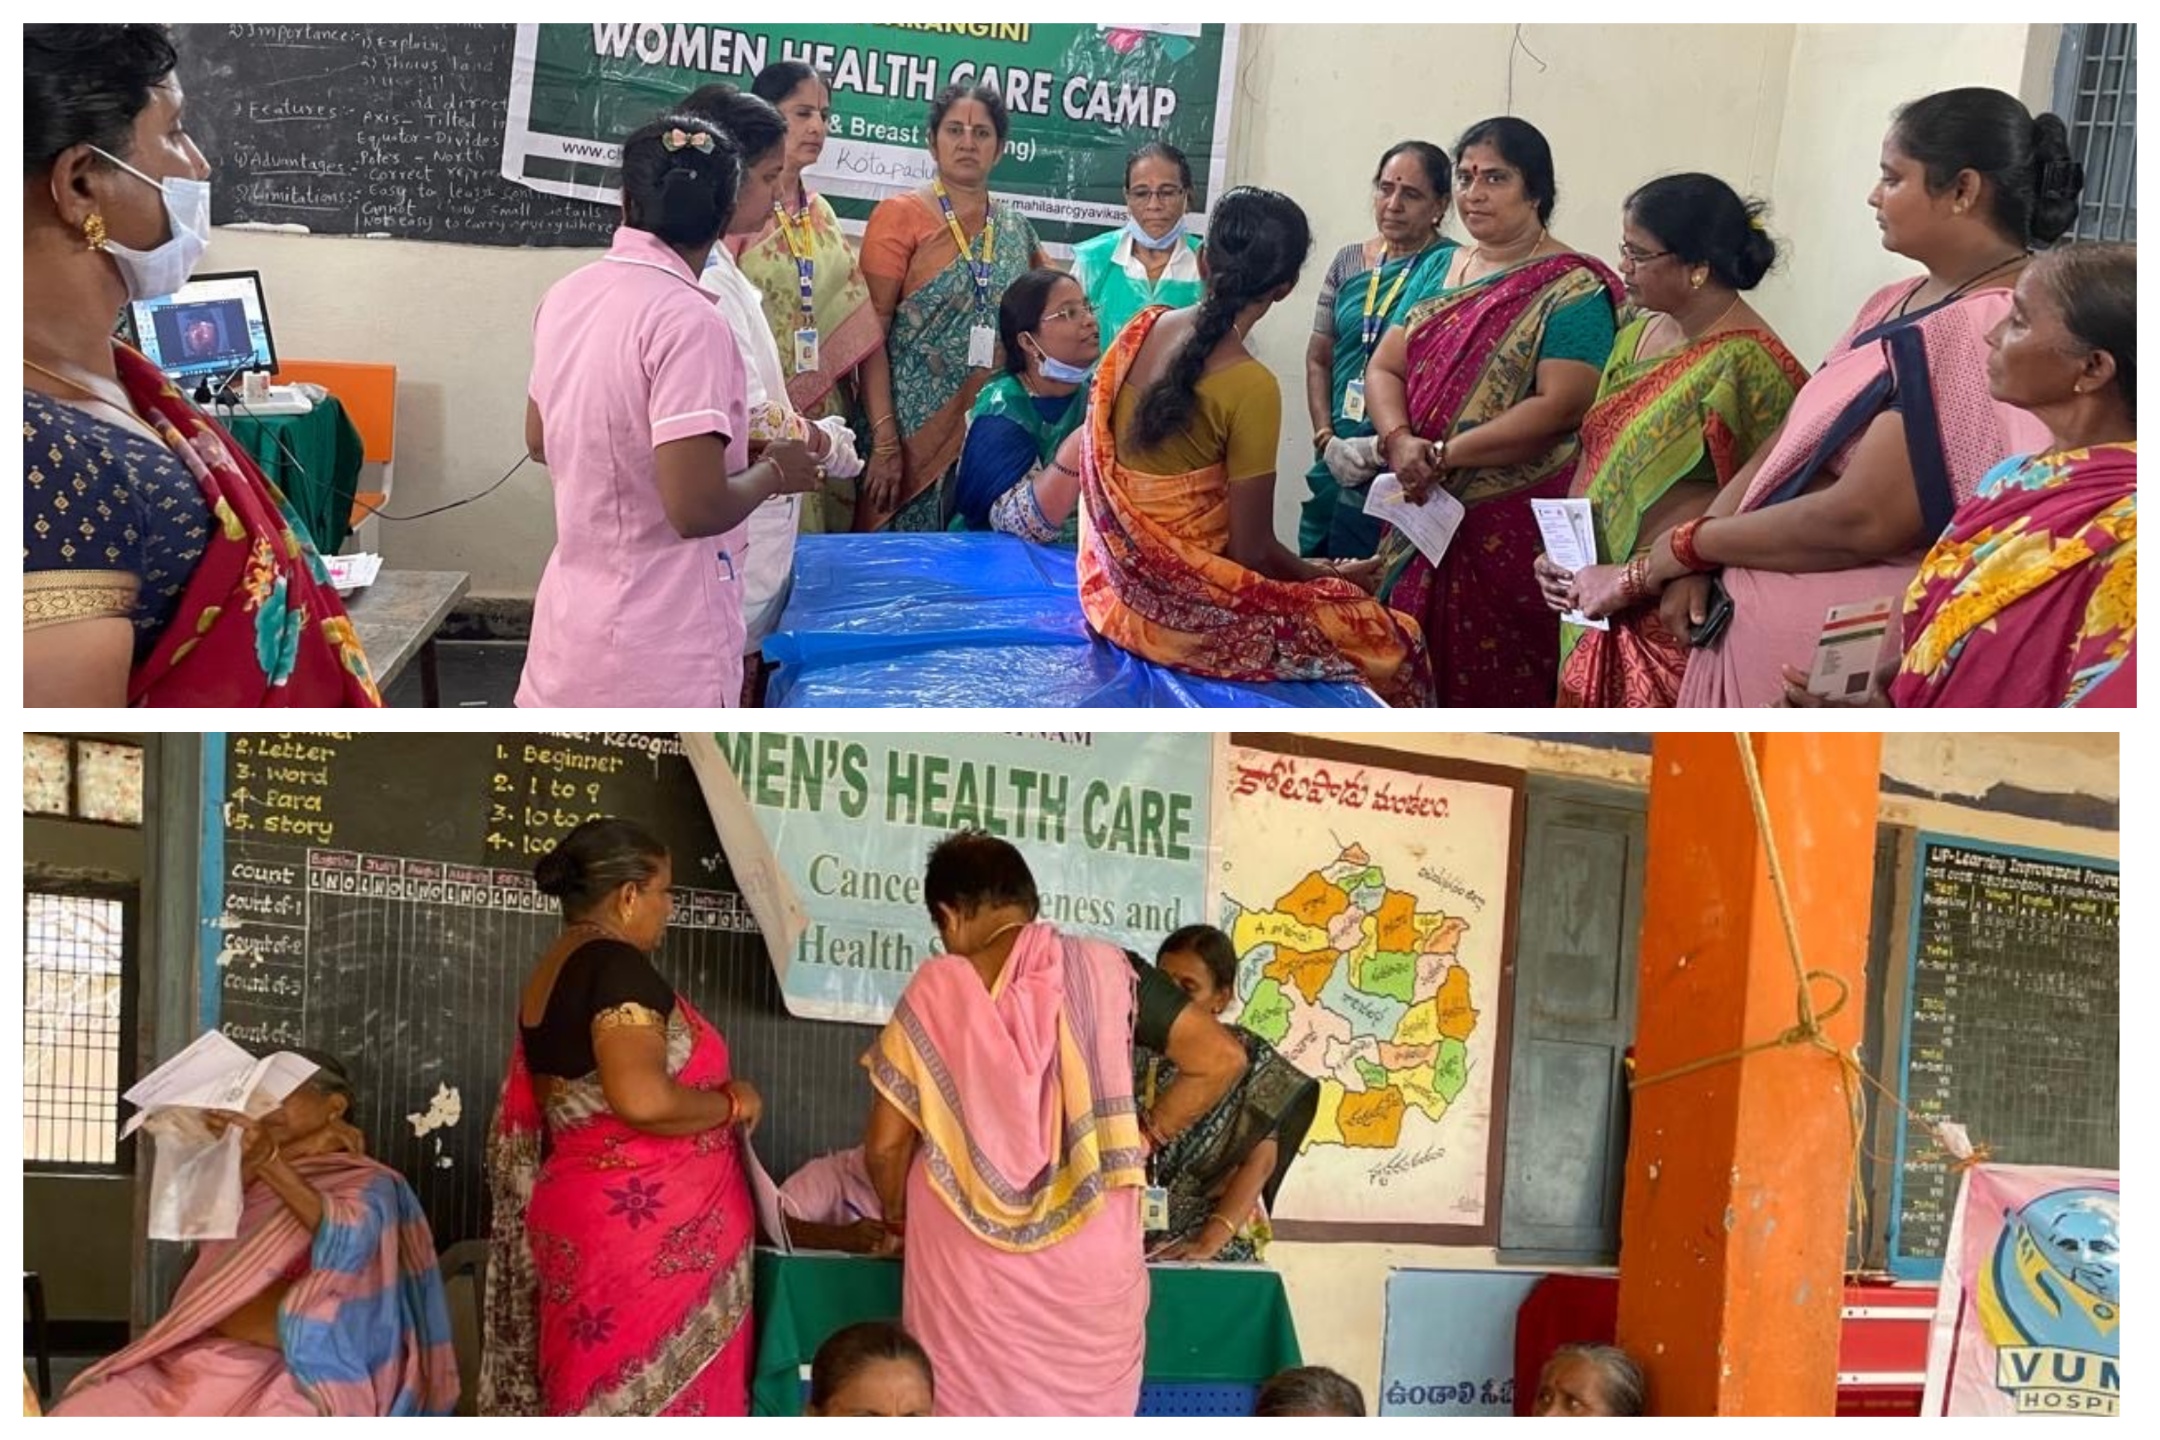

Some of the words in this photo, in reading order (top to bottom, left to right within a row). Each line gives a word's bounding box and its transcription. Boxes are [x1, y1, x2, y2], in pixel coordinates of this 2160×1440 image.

[591, 23, 769, 77] WOMEN
[782, 39, 937, 100] HEALTH
[949, 61, 1053, 114] CARE
[1062, 75, 1177, 128] CAMP
[828, 113, 843, 134] &
[850, 116, 919, 143] Breast
[258, 738, 336, 762] Letter
[523, 745, 624, 773] Beginner
[236, 762, 256, 779] 3.
[494, 774, 515, 792] 2.
[551, 779, 576, 798] to
[266, 788, 322, 811] Para
[885, 750, 1069, 843] HEALTH
[1083, 779, 1193, 861] CARE
[490, 803, 514, 822] 3.
[525, 806, 549, 827] 10
[553, 808, 580, 828] to
[486, 832, 515, 850] 4.
[809, 854, 920, 904] Cance
[1038, 891, 1115, 926] eness
[1126, 897, 1182, 933] and
[798, 924, 914, 972] Health
